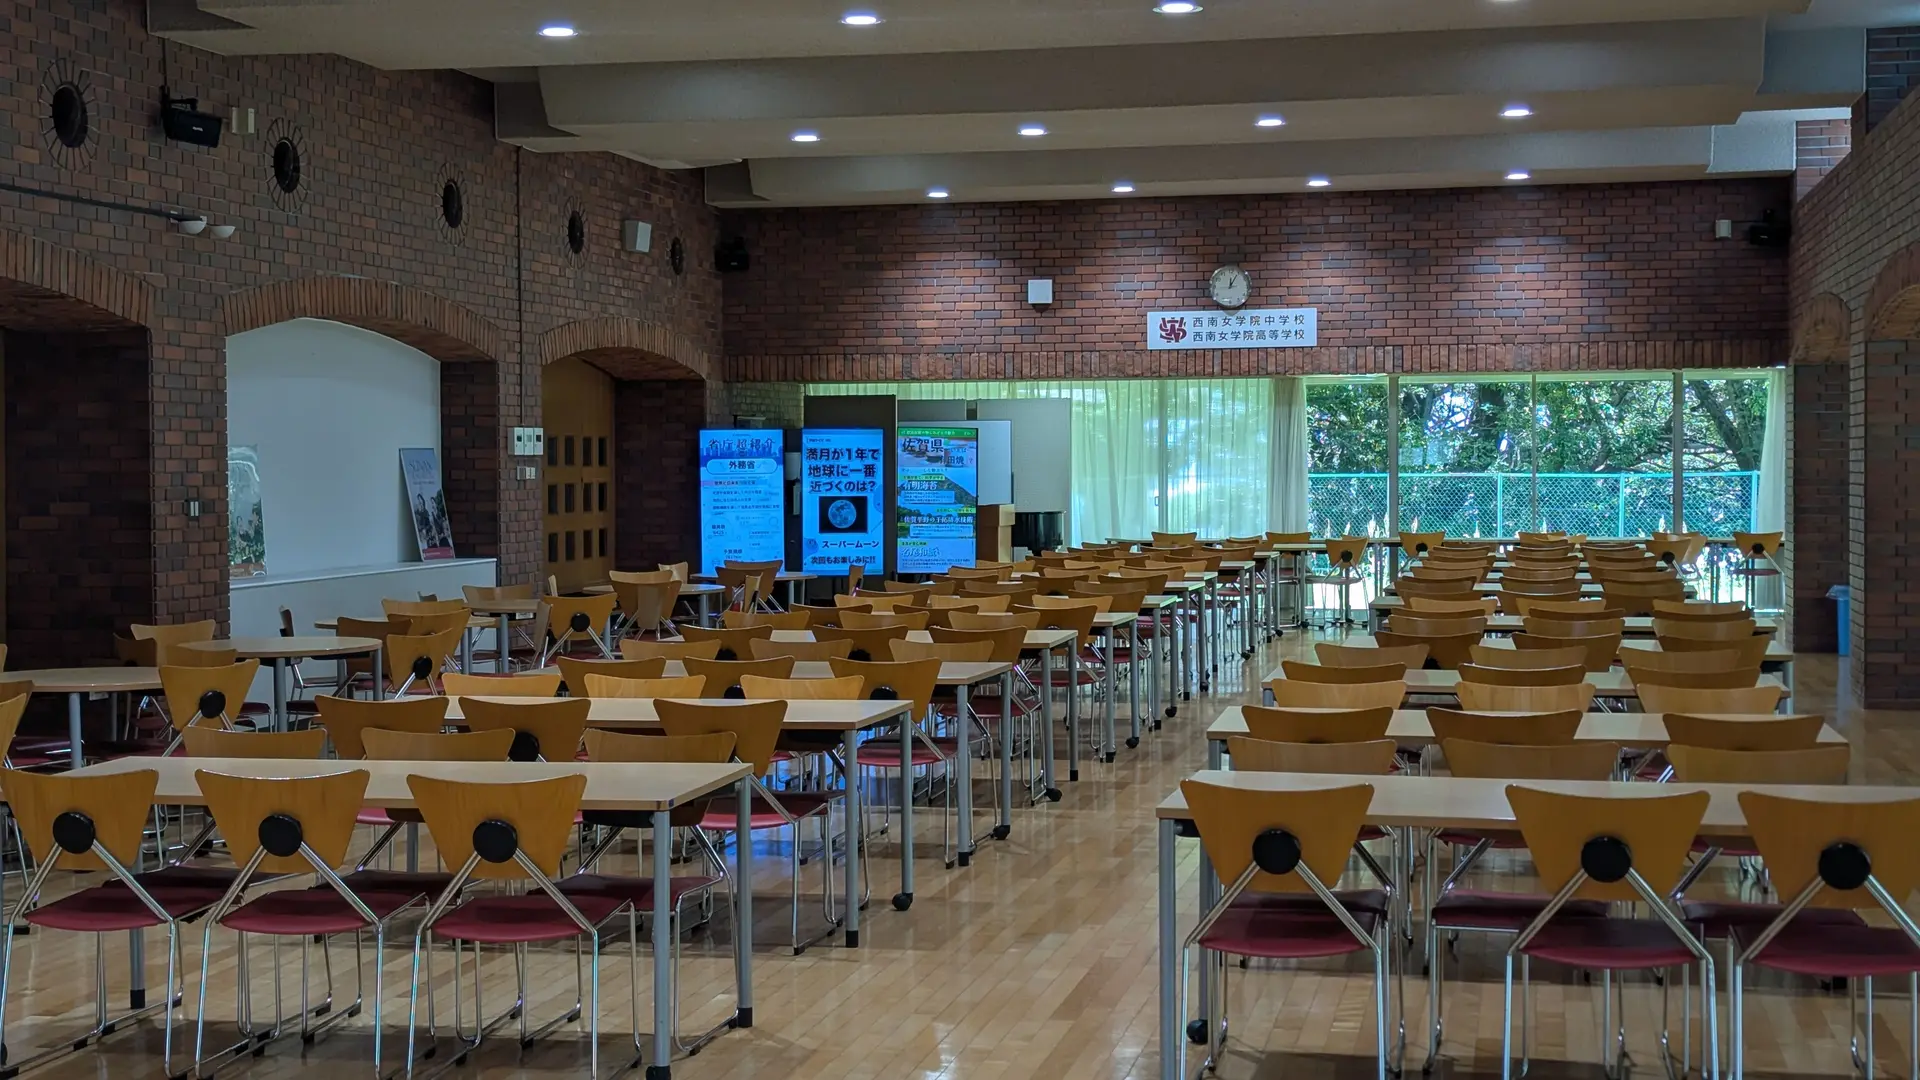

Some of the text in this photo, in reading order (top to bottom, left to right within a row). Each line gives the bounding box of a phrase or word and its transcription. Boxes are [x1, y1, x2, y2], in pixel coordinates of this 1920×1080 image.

[1192, 314, 1305, 328] 西南女学院中学校
[1192, 329, 1305, 342] 西南女学院高等学校
[902, 438, 944, 453] 佐賀県
[806, 448, 880, 461] 満月が1年で
[729, 461, 755, 470] 外務省
[807, 464, 876, 478] 地球に一番
[810, 480, 876, 493] 近づくのは?
[822, 540, 880, 549] スーパームーン
